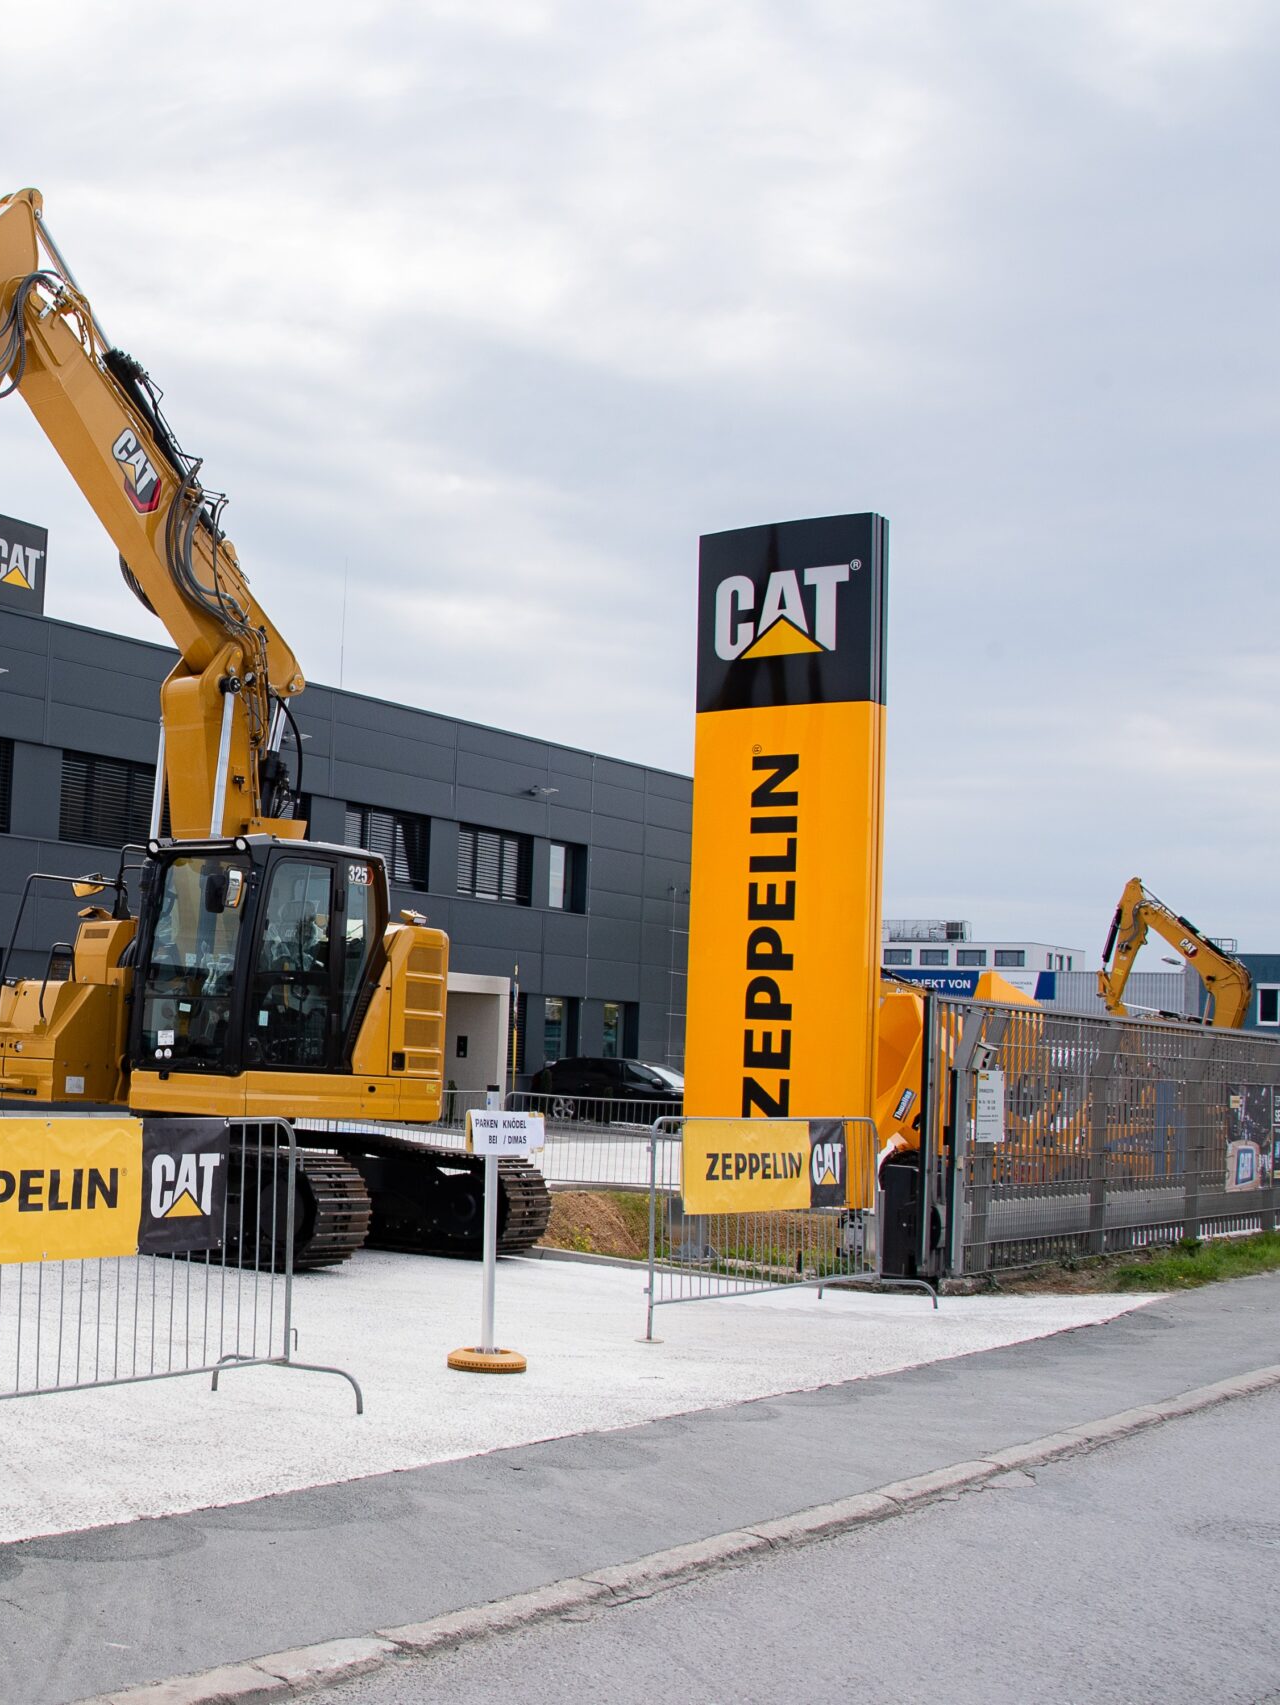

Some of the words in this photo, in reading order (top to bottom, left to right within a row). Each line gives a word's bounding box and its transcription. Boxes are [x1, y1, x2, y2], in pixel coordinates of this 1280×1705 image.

[112, 428, 158, 495] CAT
[715, 564, 850, 661] CAT
[348, 866, 368, 884] 325
[949, 979, 971, 989] VON
[475, 1119, 498, 1128] PARKEN
[489, 1135, 498, 1144] BEI
[508, 1135, 527, 1144] DIMAS
[705, 1152, 802, 1181] ZEPPELIN
[811, 1143, 842, 1185] CAT
[150, 1152, 220, 1219] CAT
